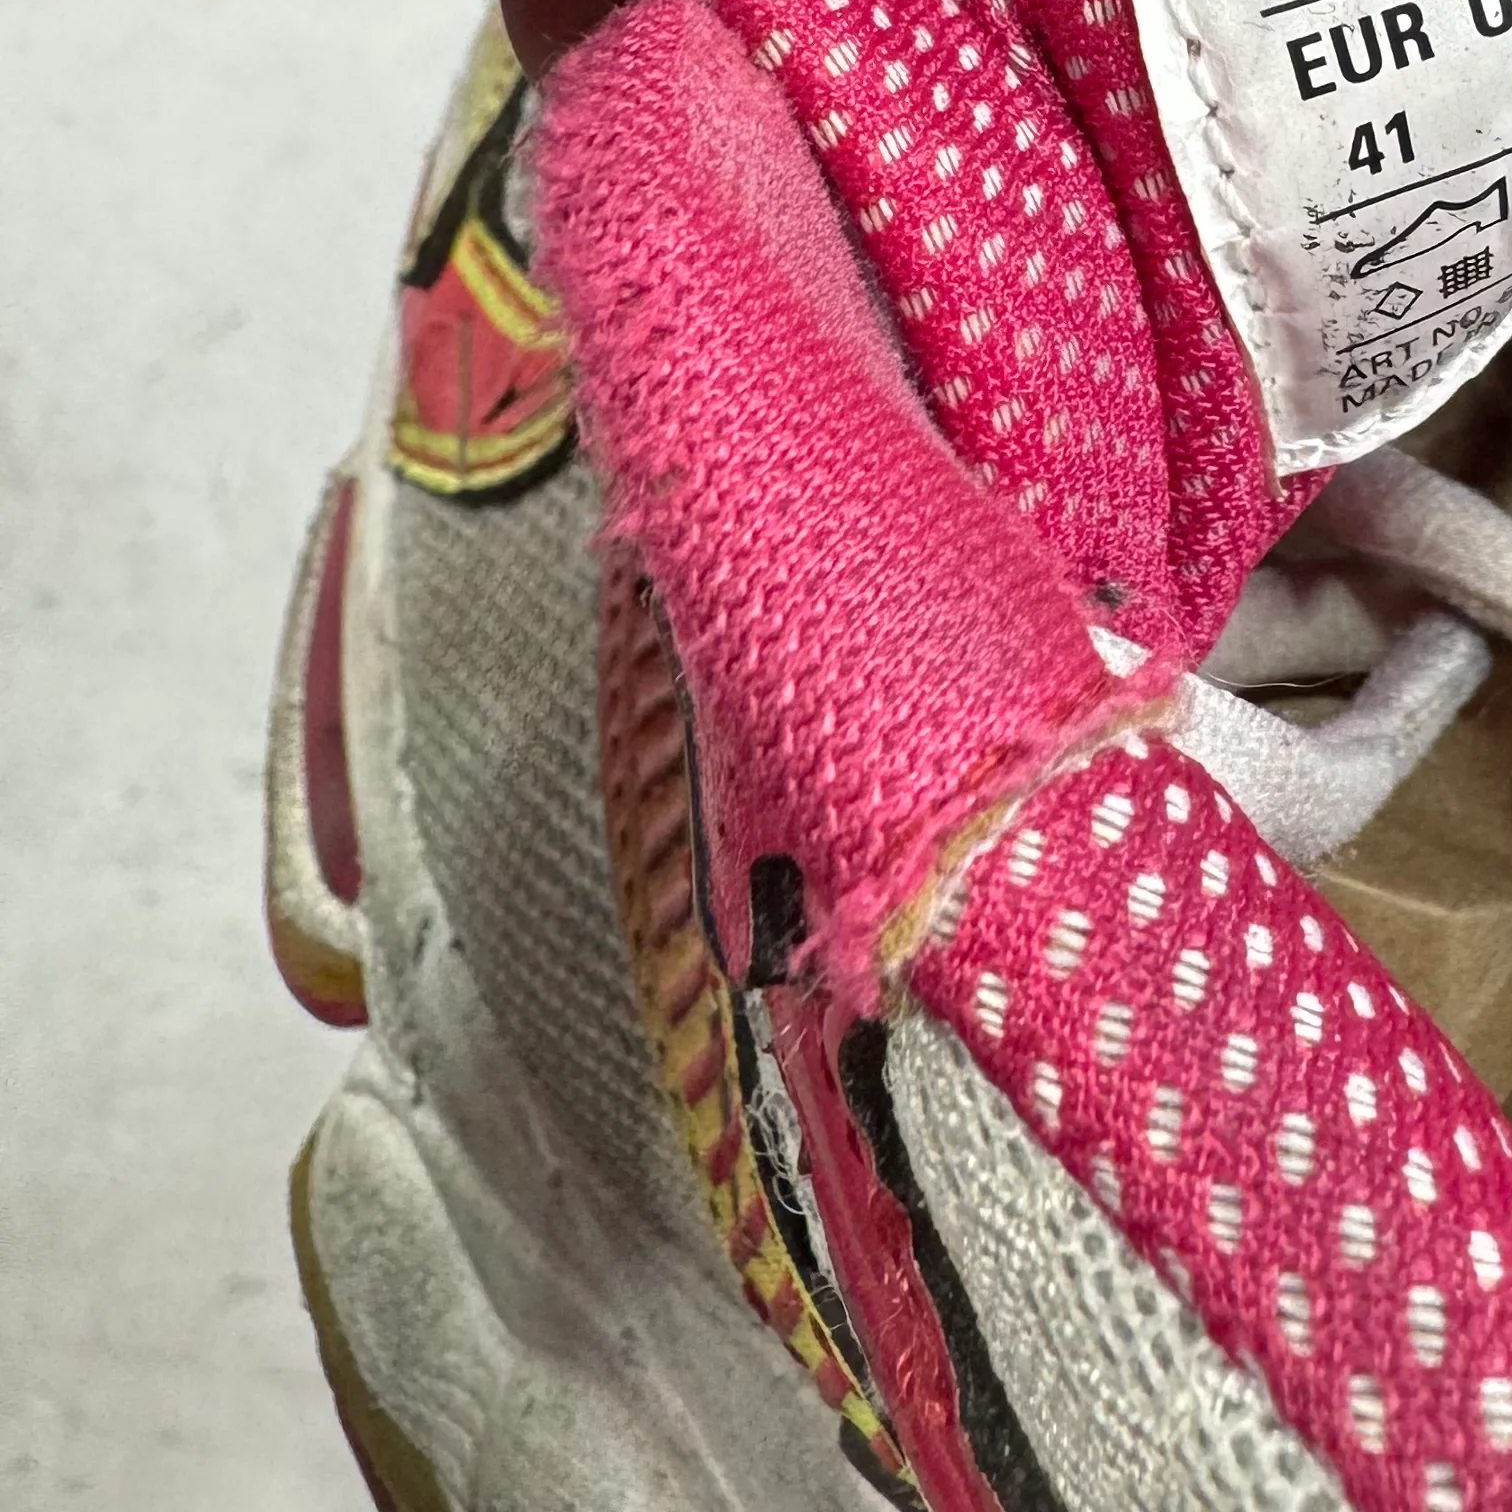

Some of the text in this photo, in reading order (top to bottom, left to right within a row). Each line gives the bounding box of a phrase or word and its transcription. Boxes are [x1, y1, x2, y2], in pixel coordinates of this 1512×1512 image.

[1286, 2, 1435, 101] EUR
[1348, 110, 1415, 174] 41
[1339, 337, 1420, 387] ART
